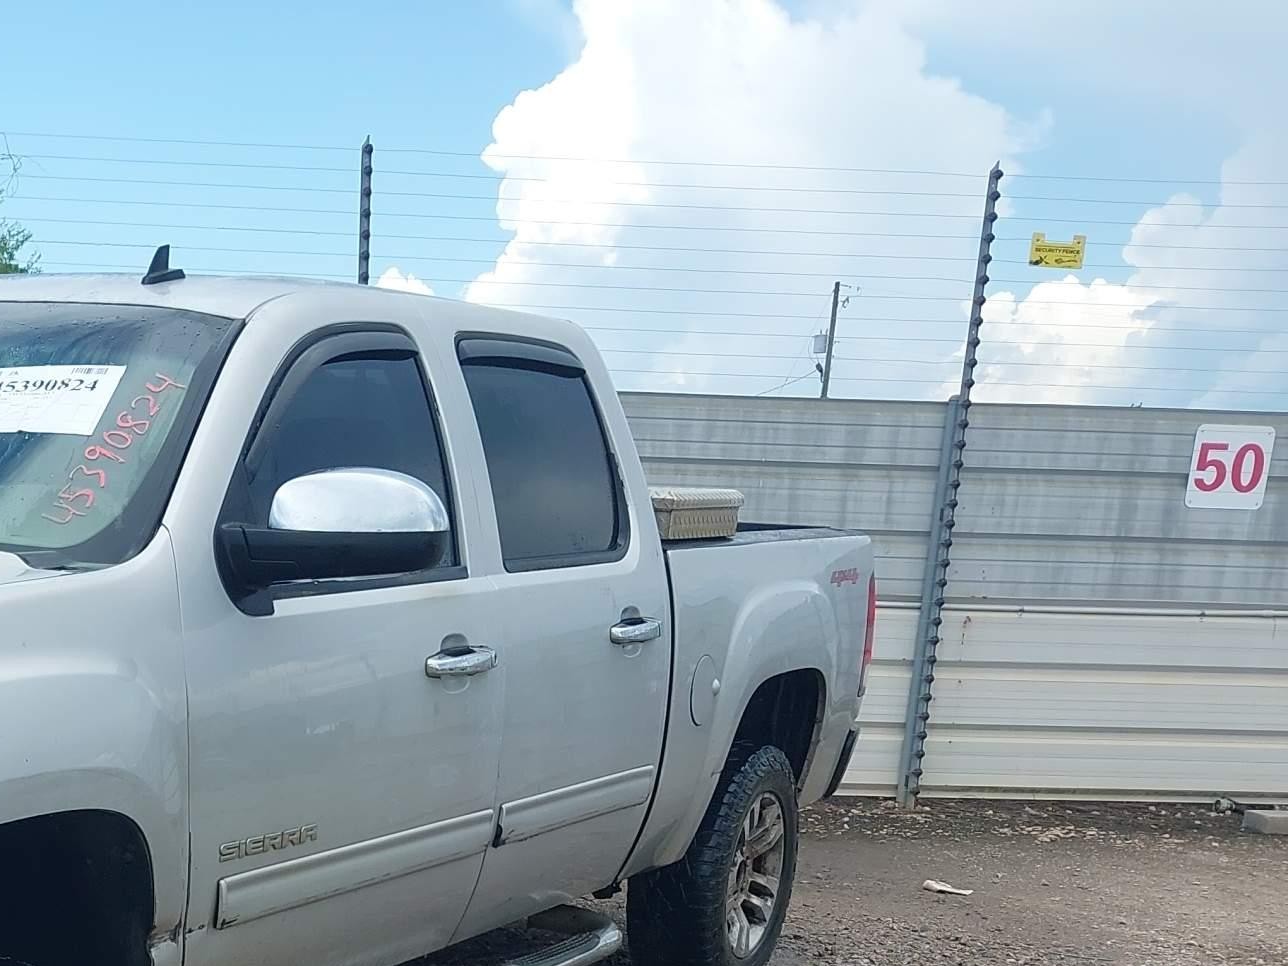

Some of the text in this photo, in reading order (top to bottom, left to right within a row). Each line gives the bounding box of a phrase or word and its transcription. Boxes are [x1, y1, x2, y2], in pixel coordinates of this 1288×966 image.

[40, 372, 187, 524] 45390824
[1194, 442, 1265, 493] 50
[219, 823, 318, 862] SIERRA
